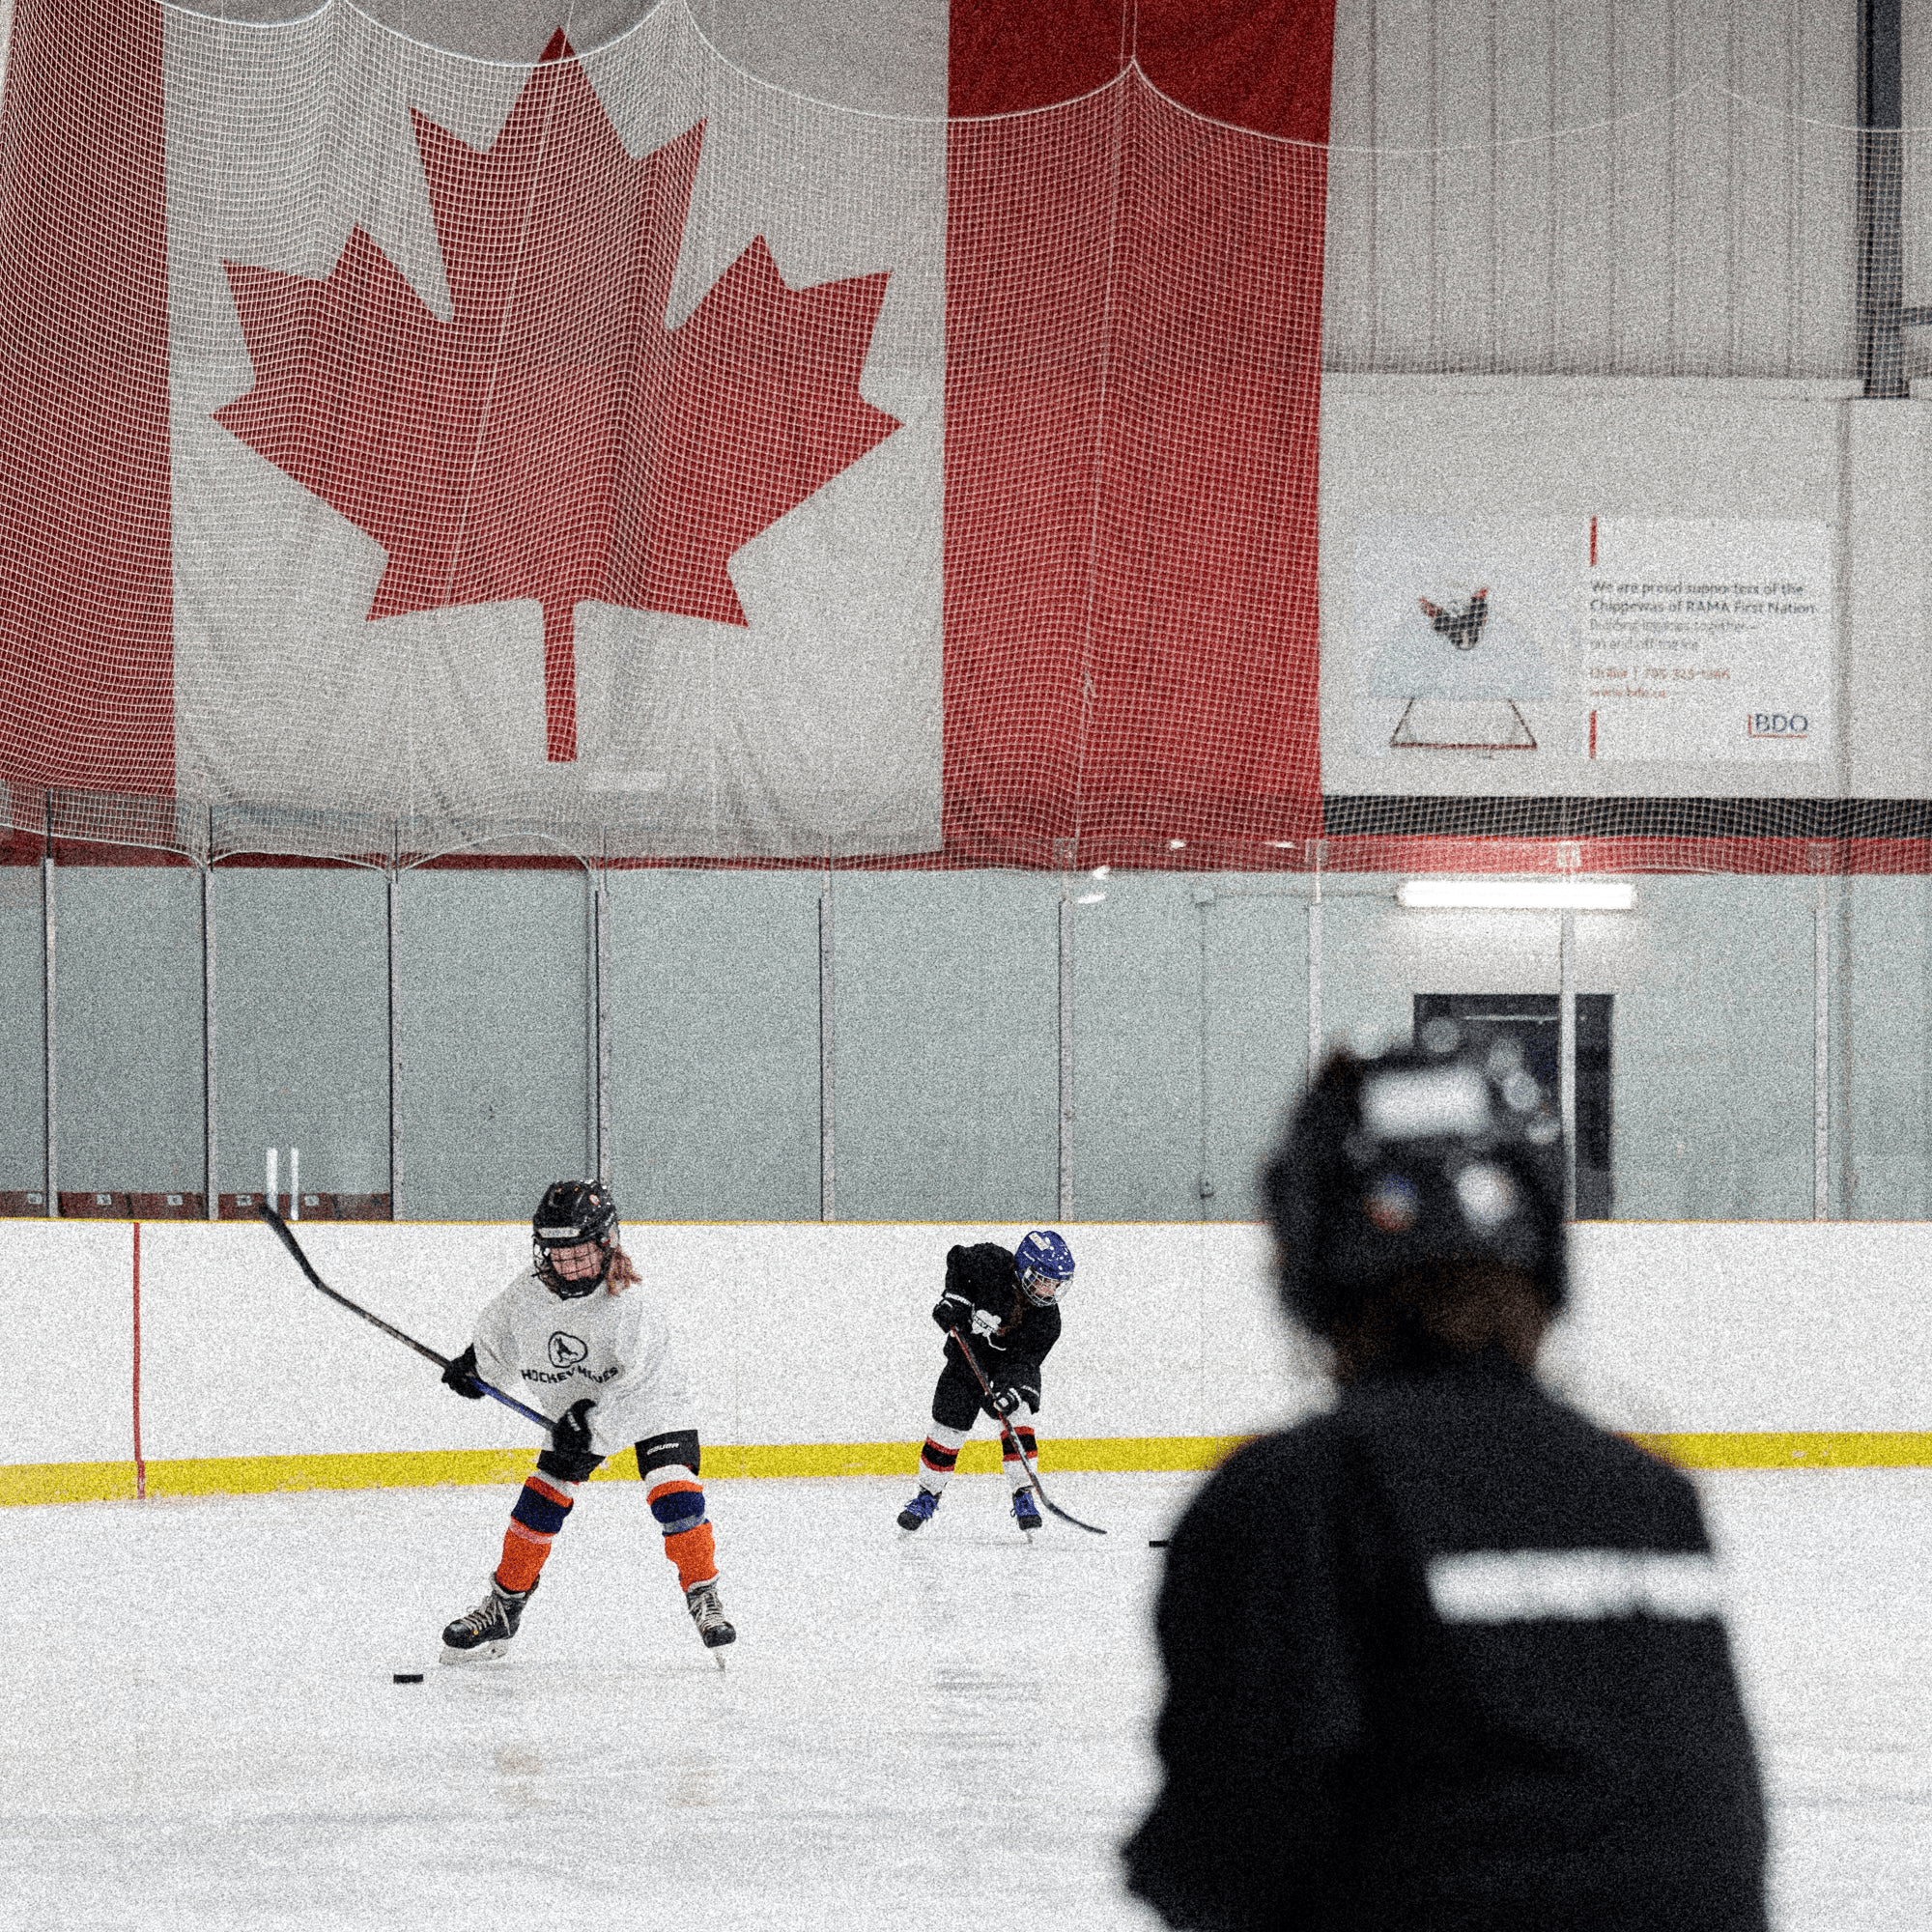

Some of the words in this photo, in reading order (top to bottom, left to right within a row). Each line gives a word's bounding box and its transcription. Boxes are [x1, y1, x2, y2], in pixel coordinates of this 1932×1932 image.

[1617, 582, 1639, 594] are
[1642, 581, 1682, 598] proud
[1686, 582, 1759, 597] supporters
[1764, 582, 1777, 596] of
[1781, 582, 1803, 596] the
[1590, 599, 1663, 615] Chippewas
[1668, 600, 1682, 613] of
[1686, 601, 1729, 612] RAMA
[1734, 600, 1763, 614] First
[1768, 601, 1814, 614] Nation
[1755, 714, 1808, 732] BDO
[521, 1366, 576, 1383] HOCKEY
